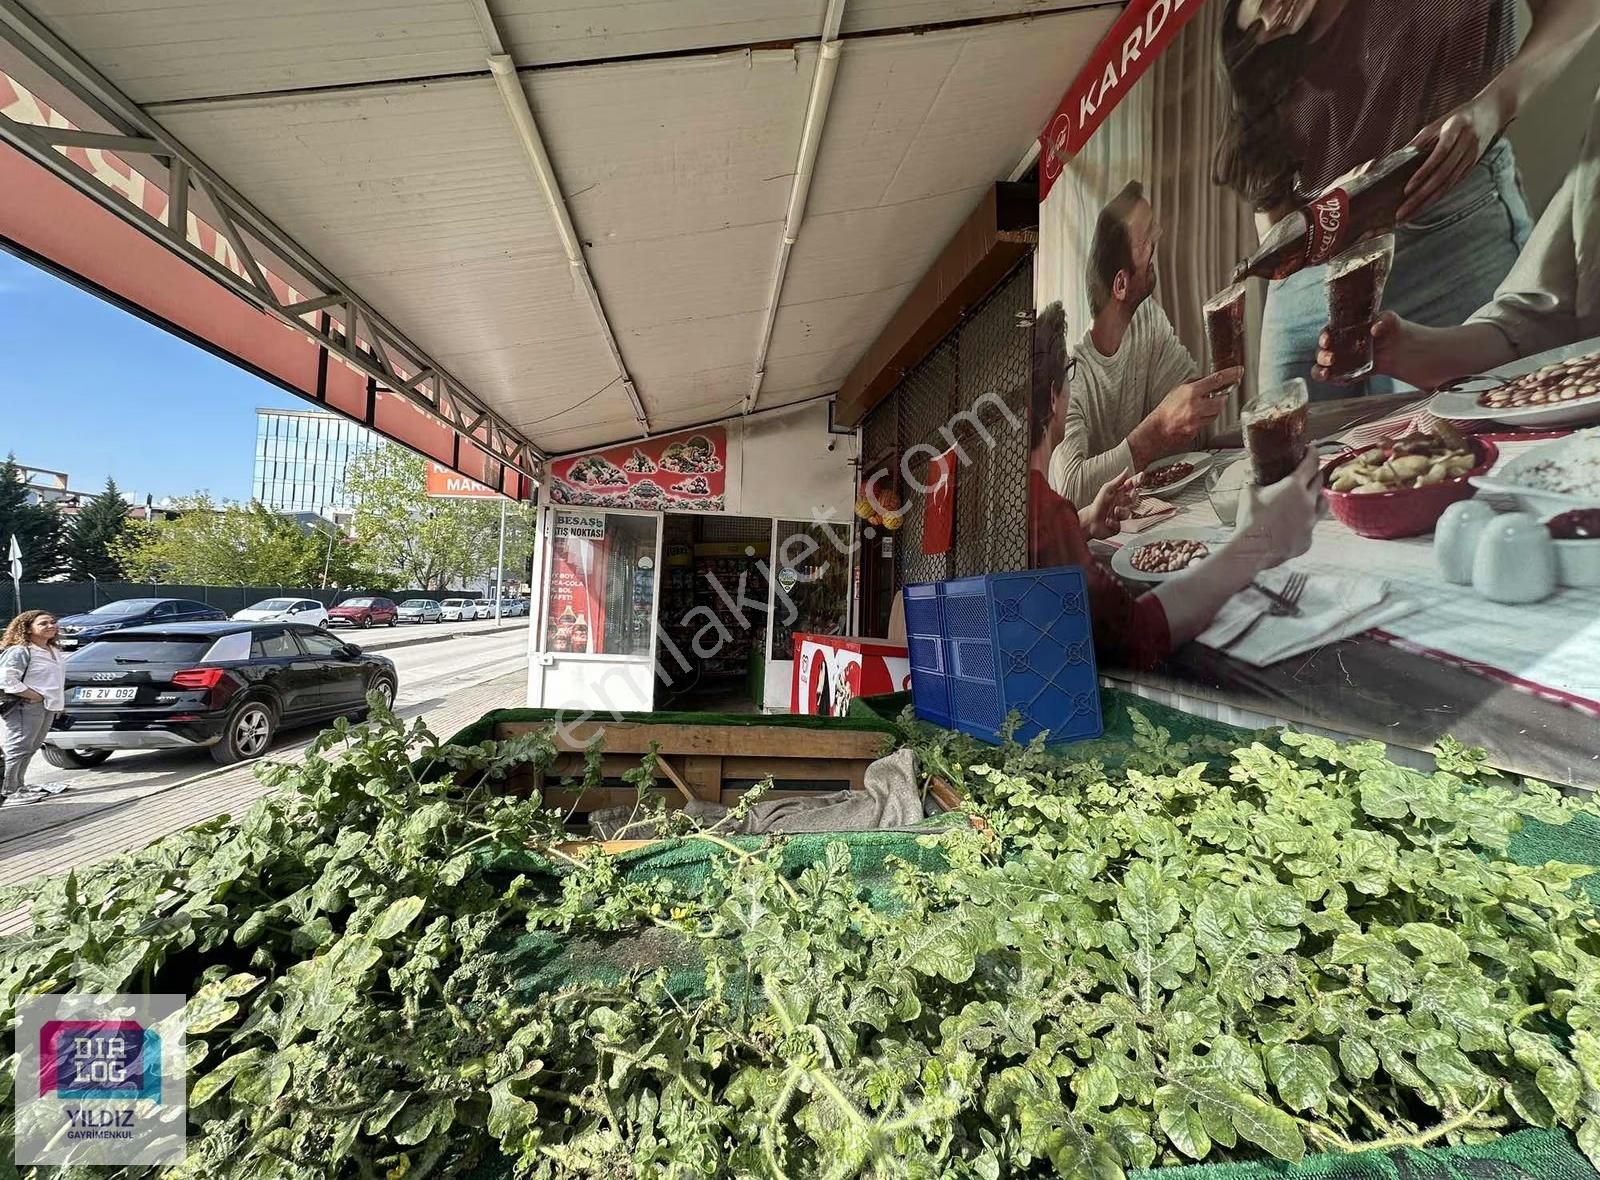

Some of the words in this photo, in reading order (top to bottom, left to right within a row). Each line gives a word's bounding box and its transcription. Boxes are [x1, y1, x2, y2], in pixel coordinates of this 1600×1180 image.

[570, 528, 604, 538] NOKTASI
[81, 689, 92, 698] 16
[96, 689, 111, 698] ZV
[115, 689, 135, 698] 092
